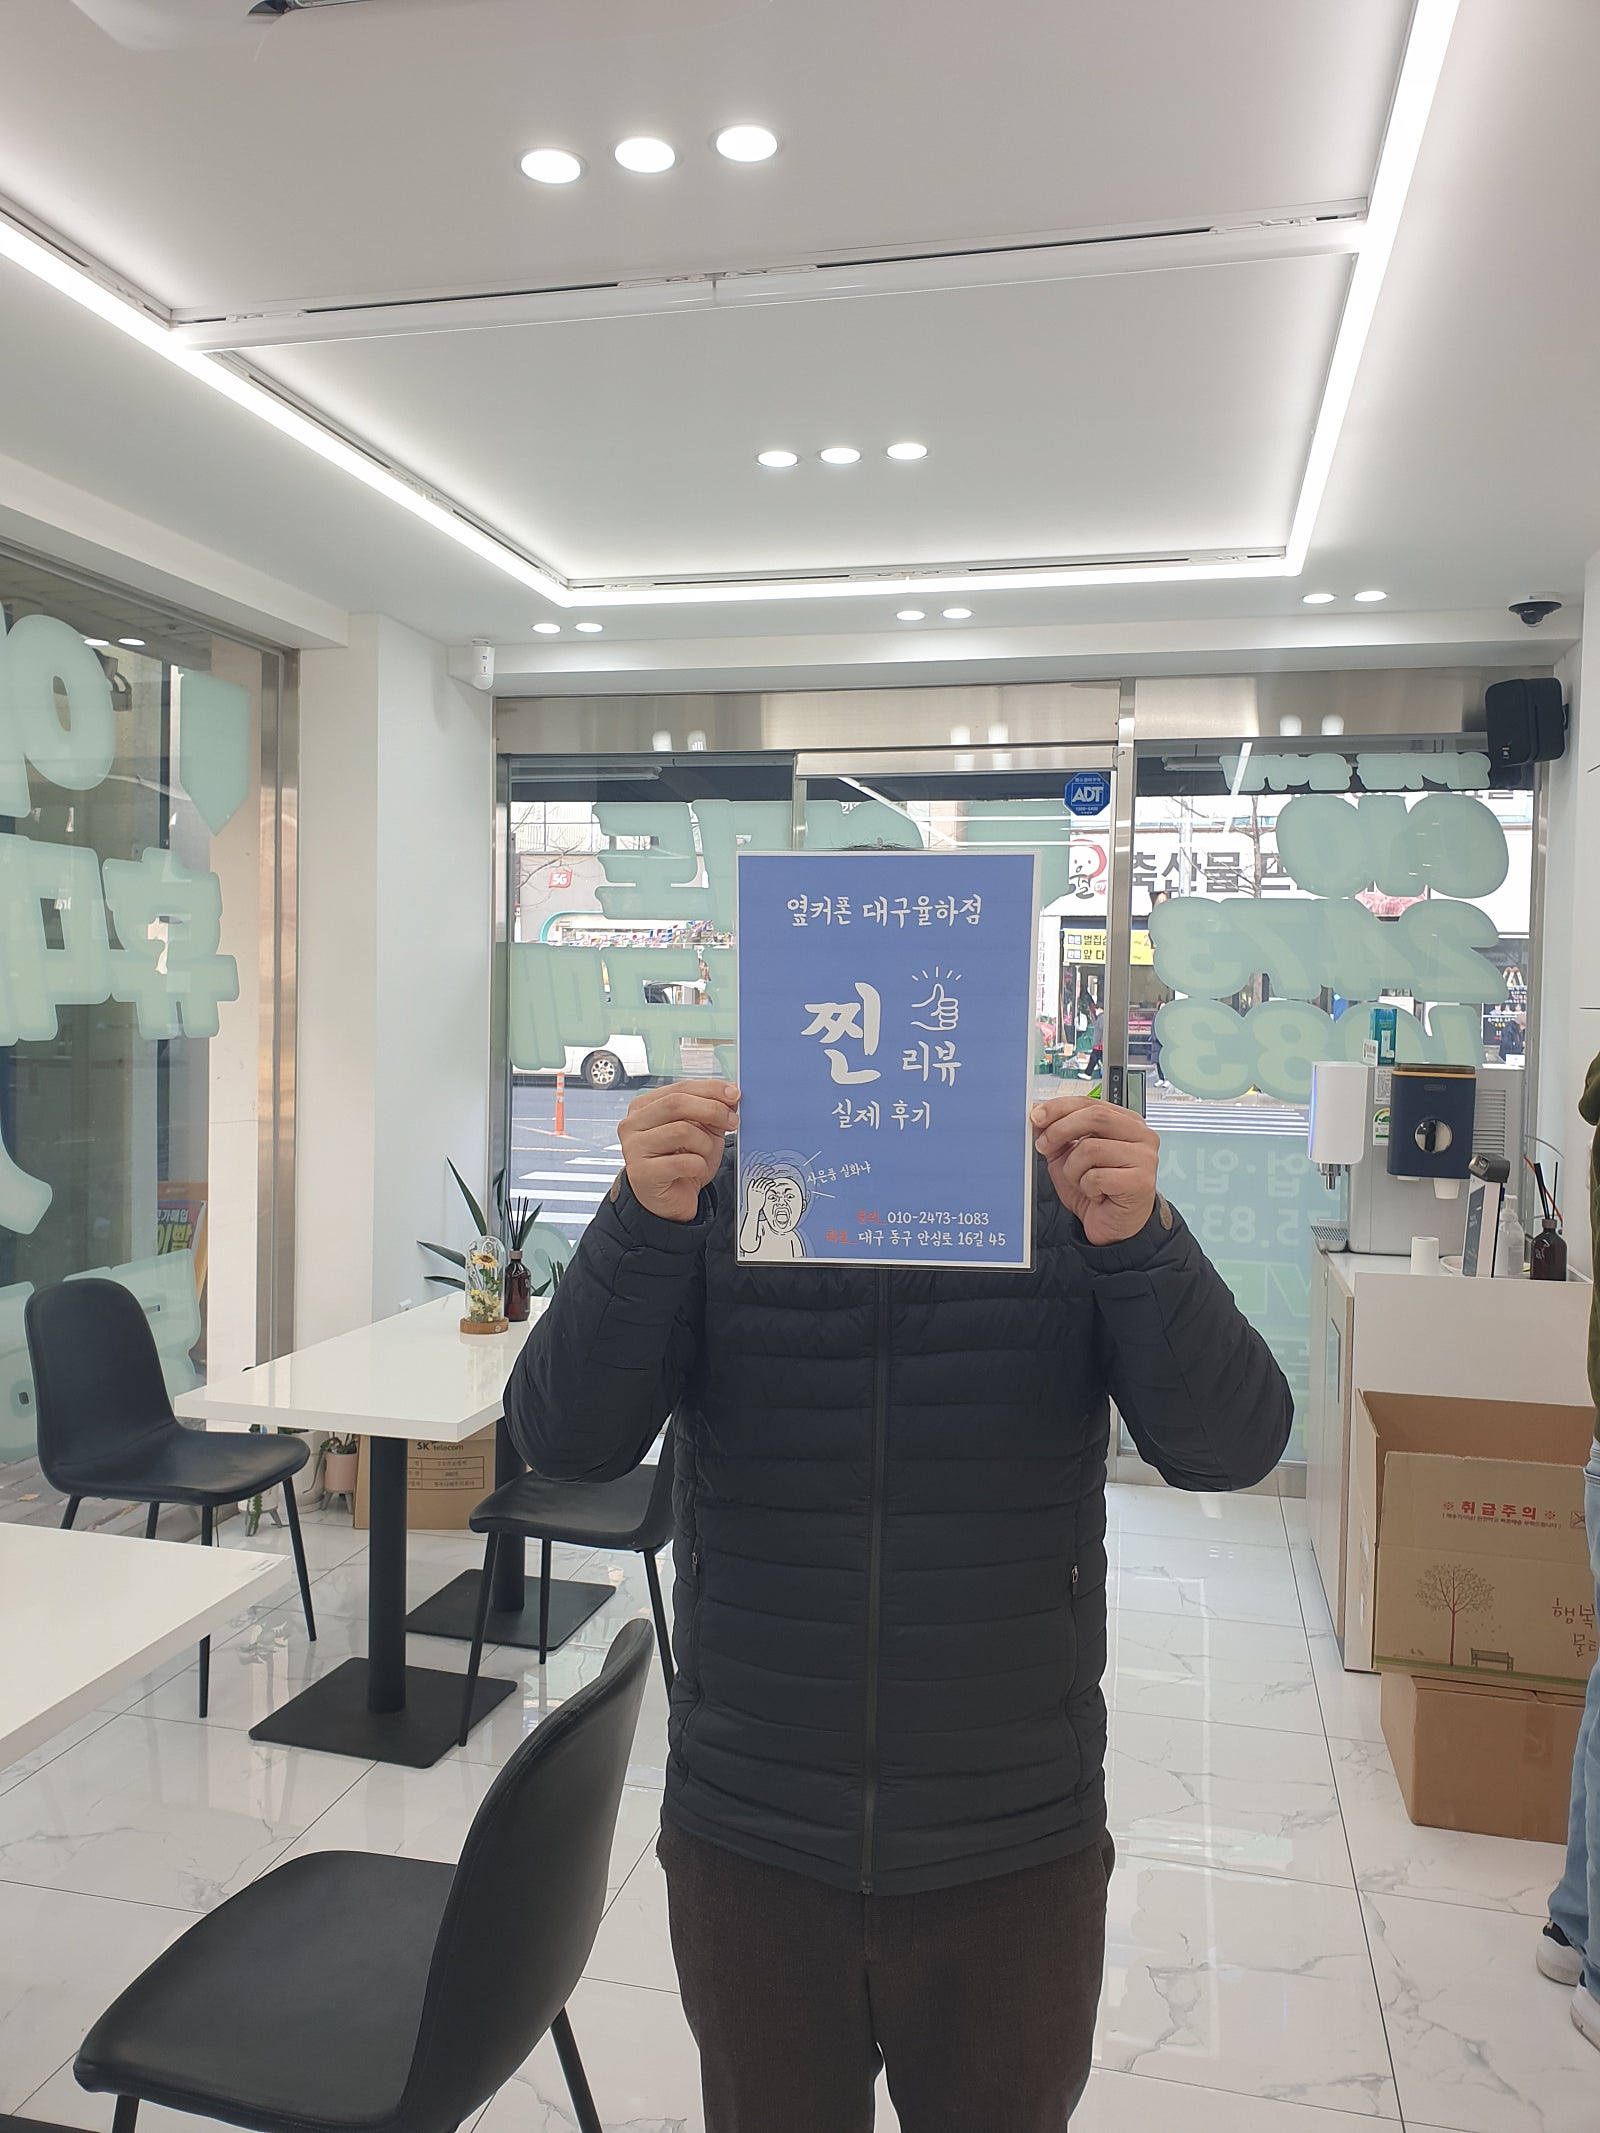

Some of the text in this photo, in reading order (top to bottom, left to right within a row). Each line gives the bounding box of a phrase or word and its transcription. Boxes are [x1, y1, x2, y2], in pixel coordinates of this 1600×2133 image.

[1071, 786, 1104, 802] ADT
[552, 873, 568, 885] 5G
[787, 893, 983, 928] 옆커폰 대구율하점
[801, 982, 882, 1085] 찐
[902, 1040, 962, 1086] 리뷰
[831, 1098, 931, 1130] 실제 후기
[840, 1160, 871, 1178] 실화냐
[858, 1229, 884, 1246] 대구
[890, 1230, 913, 1247] 동구
[917, 1231, 953, 1247] 안심로
[958, 1231, 984, 1247] 16길
[988, 1232, 1006, 1246] 45
[417, 1442, 430, 1450] SK
[1461, 1501, 1537, 1520] 취급주의
